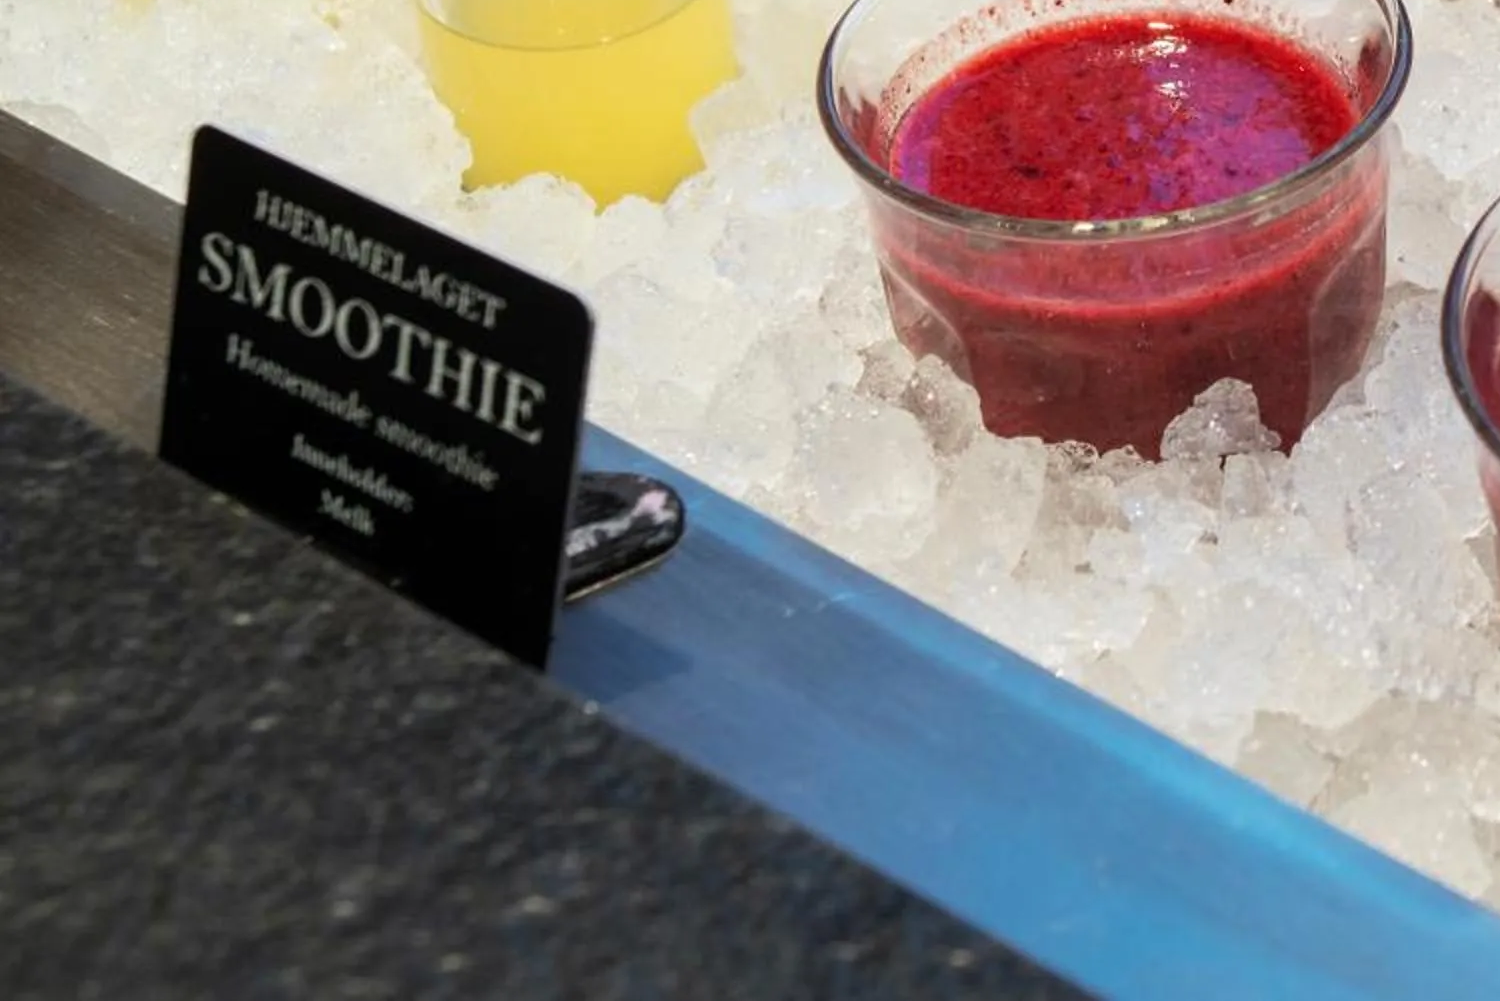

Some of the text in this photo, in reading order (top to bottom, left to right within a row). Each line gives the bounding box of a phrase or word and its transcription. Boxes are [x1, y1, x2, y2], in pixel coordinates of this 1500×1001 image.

[198, 231, 546, 445] SMOOTHIE
[253, 189, 507, 330] HJEMMELAGET
[226, 332, 499, 492] Homemade smoothie
